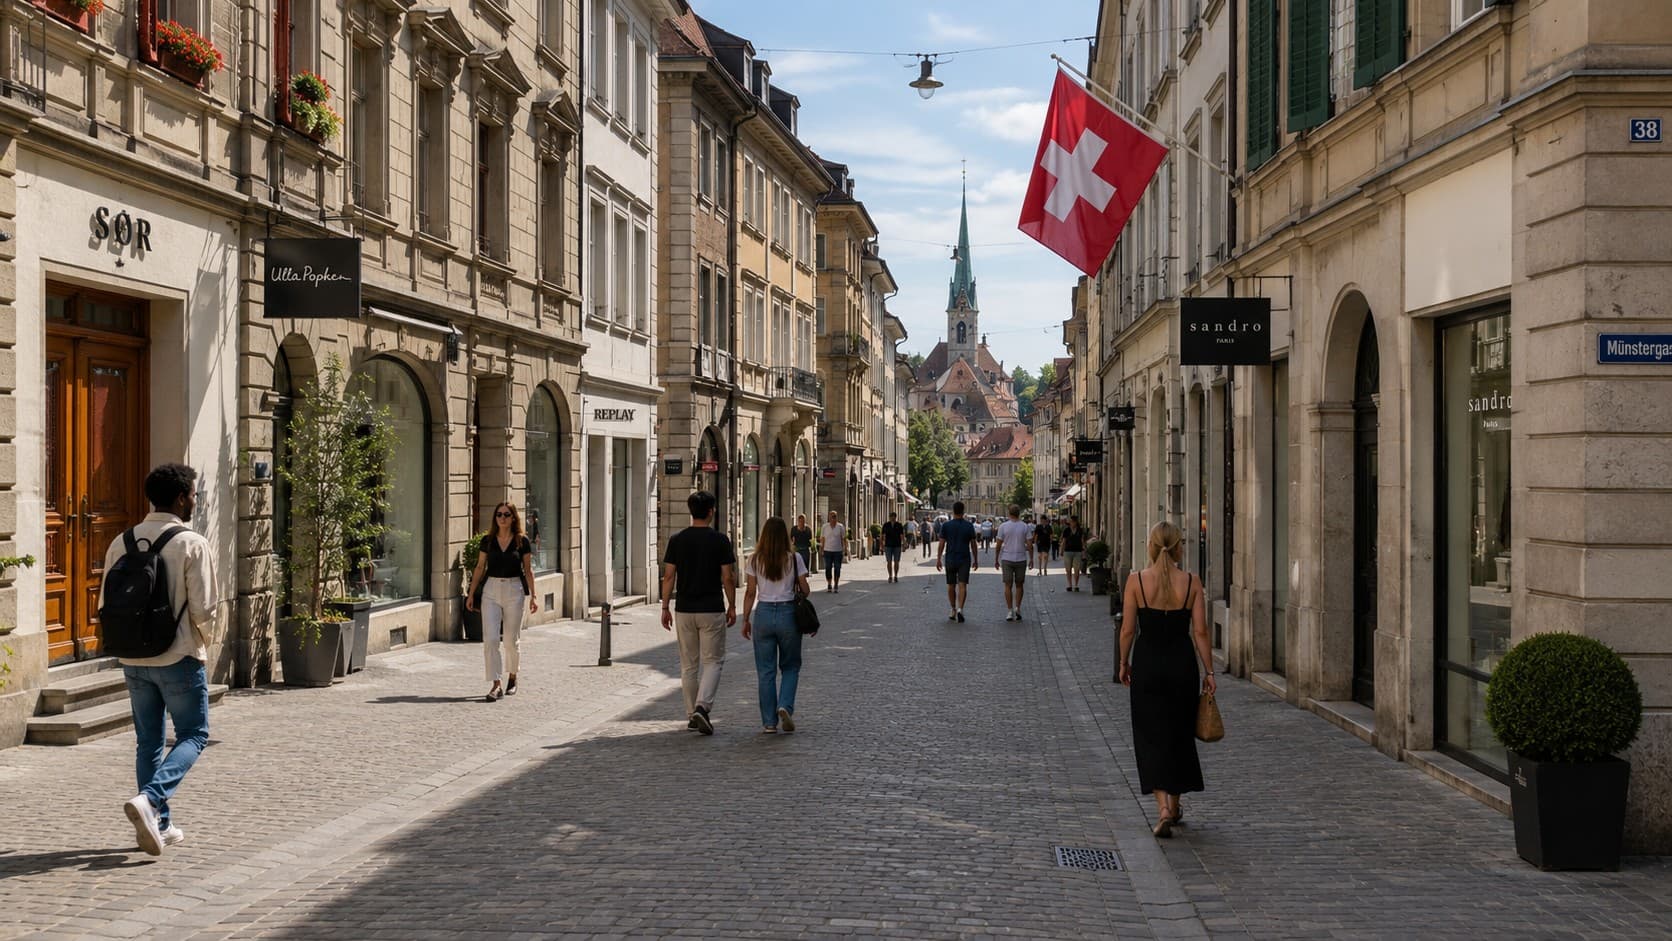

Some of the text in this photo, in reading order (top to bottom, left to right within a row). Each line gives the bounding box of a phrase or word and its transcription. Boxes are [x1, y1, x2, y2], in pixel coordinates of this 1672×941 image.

[1635, 121, 1657, 138] 38
[95, 206, 152, 252] SØR
[271, 265, 352, 288] Ulla Popken
[1189, 319, 1262, 332] sandro
[1468, 390, 1512, 412] sandro
[593, 408, 636, 422] REPLAY
